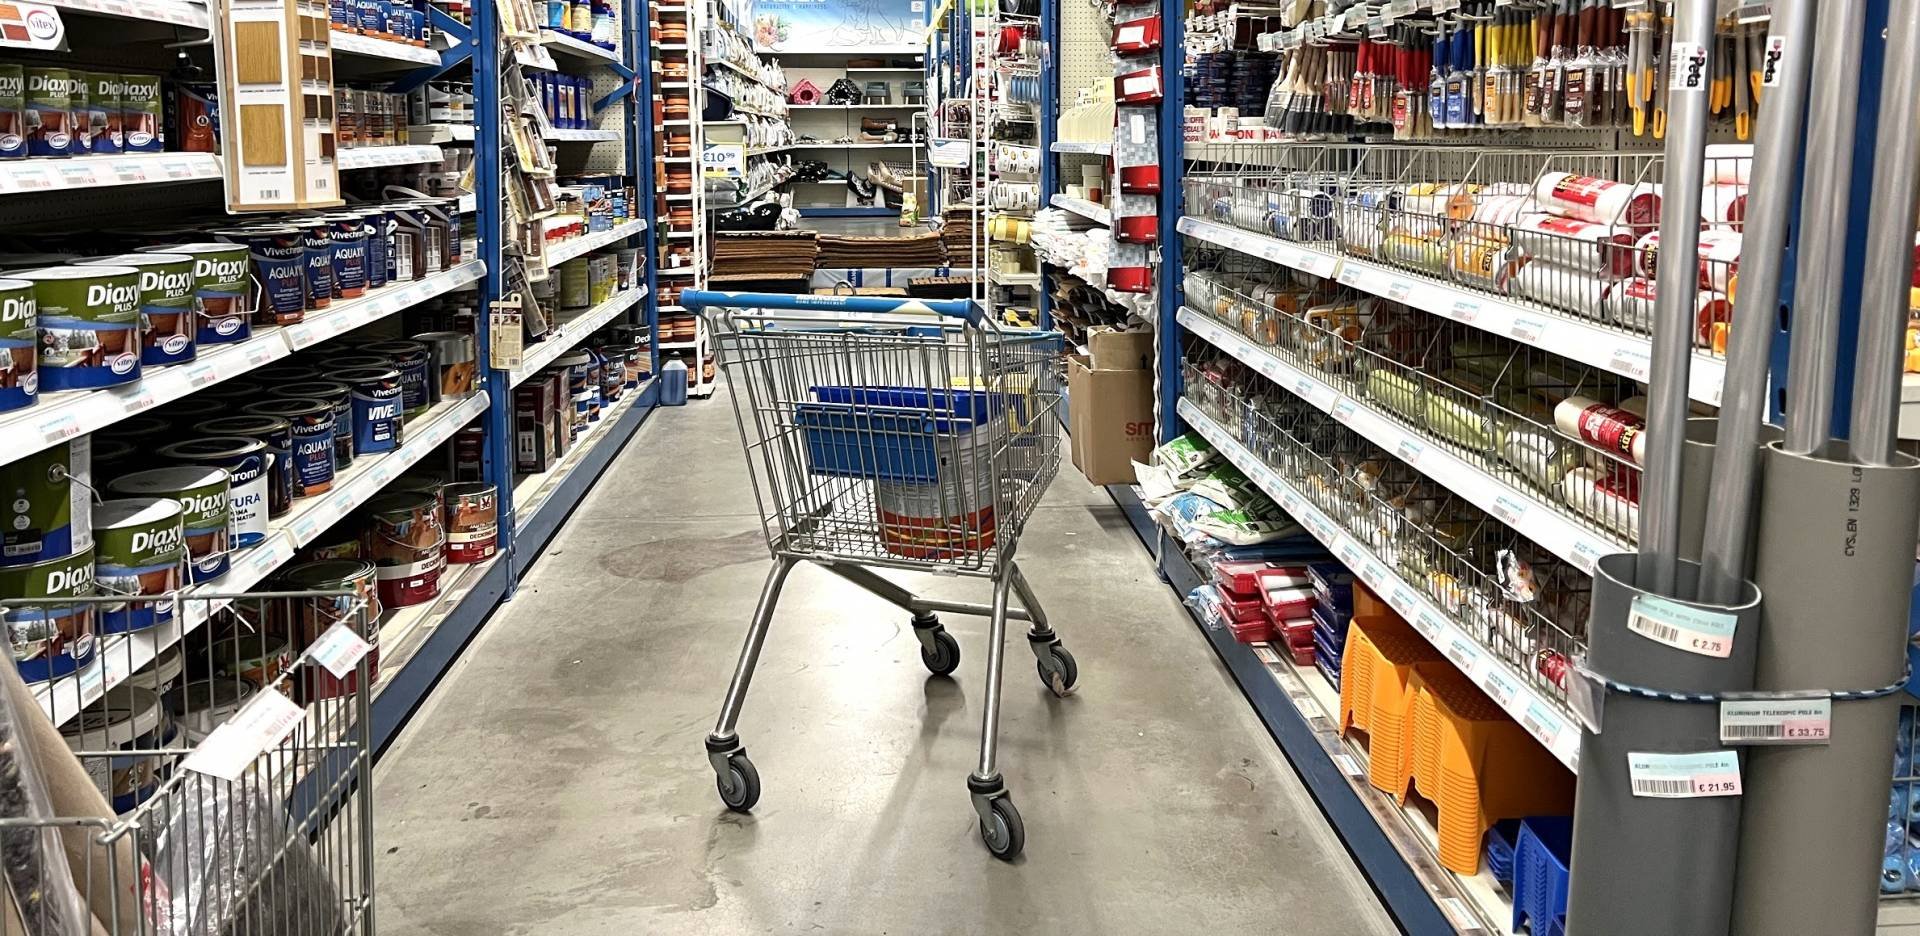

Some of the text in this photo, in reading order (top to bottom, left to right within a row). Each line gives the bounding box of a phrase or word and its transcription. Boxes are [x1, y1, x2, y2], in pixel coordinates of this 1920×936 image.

[1687, 56, 1705, 87] Peta
[1764, 51, 1782, 83] Peta
[218, 274, 237, 283] PLUS
[166, 288, 184, 298] PLUS
[114, 303, 133, 313] PLUS
[202, 509, 220, 519] PLUS
[154, 543, 176, 555] PLUS
[72, 583, 90, 596] PLUS
[1702, 640, 1722, 651] 2.75
[1797, 728, 1825, 737] 33.75
[1708, 782, 1736, 792] 21.95
